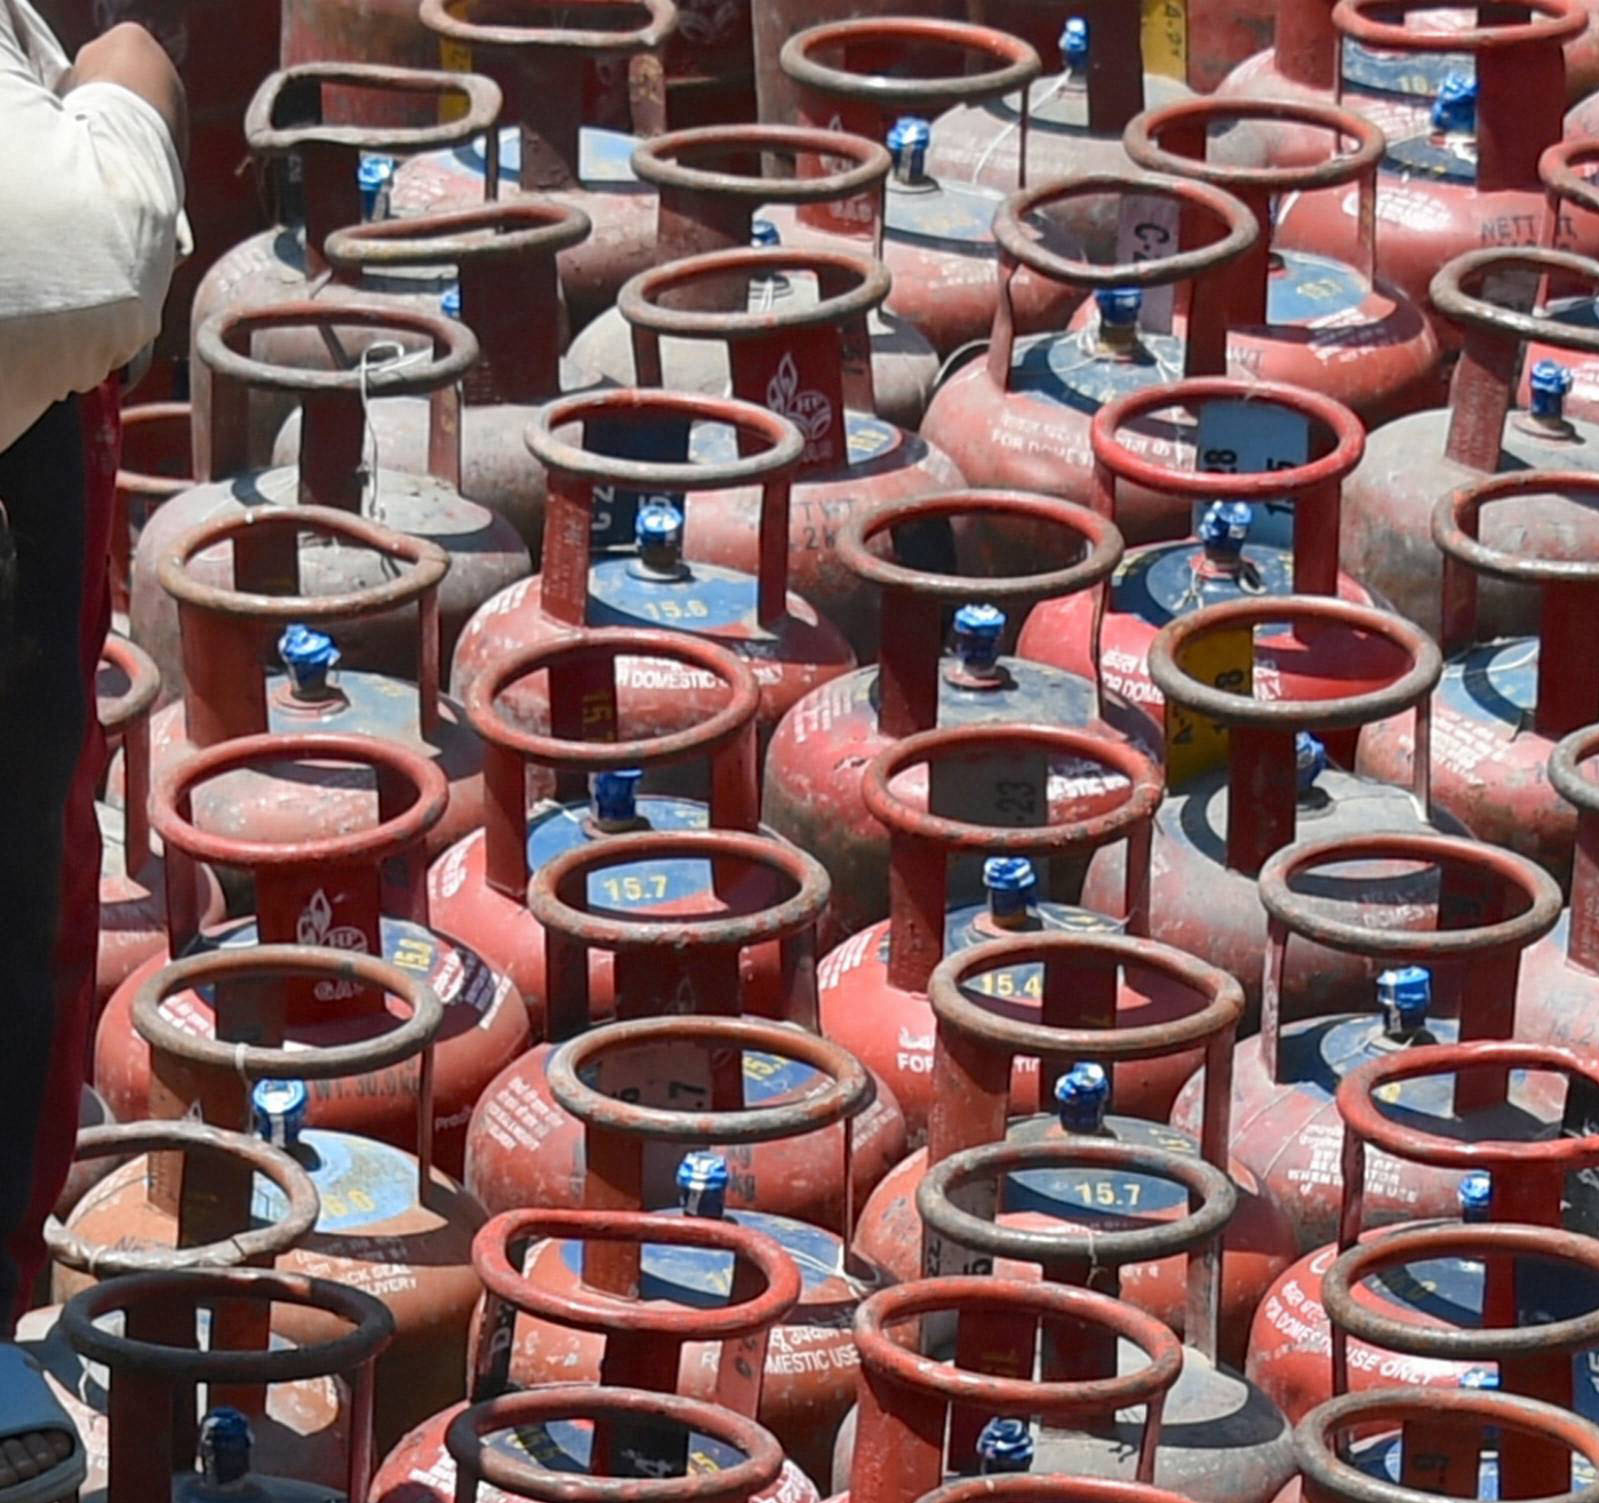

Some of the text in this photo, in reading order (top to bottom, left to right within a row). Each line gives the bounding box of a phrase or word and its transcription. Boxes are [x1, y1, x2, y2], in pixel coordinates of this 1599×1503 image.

[603, 874, 668, 901] 15.7
[982, 972, 1043, 999] 15.4
[1075, 1182, 1141, 1207] 15.7
[763, 1343, 862, 1375] MESTIC USE
[1380, 1354, 1435, 1386] ONLY
